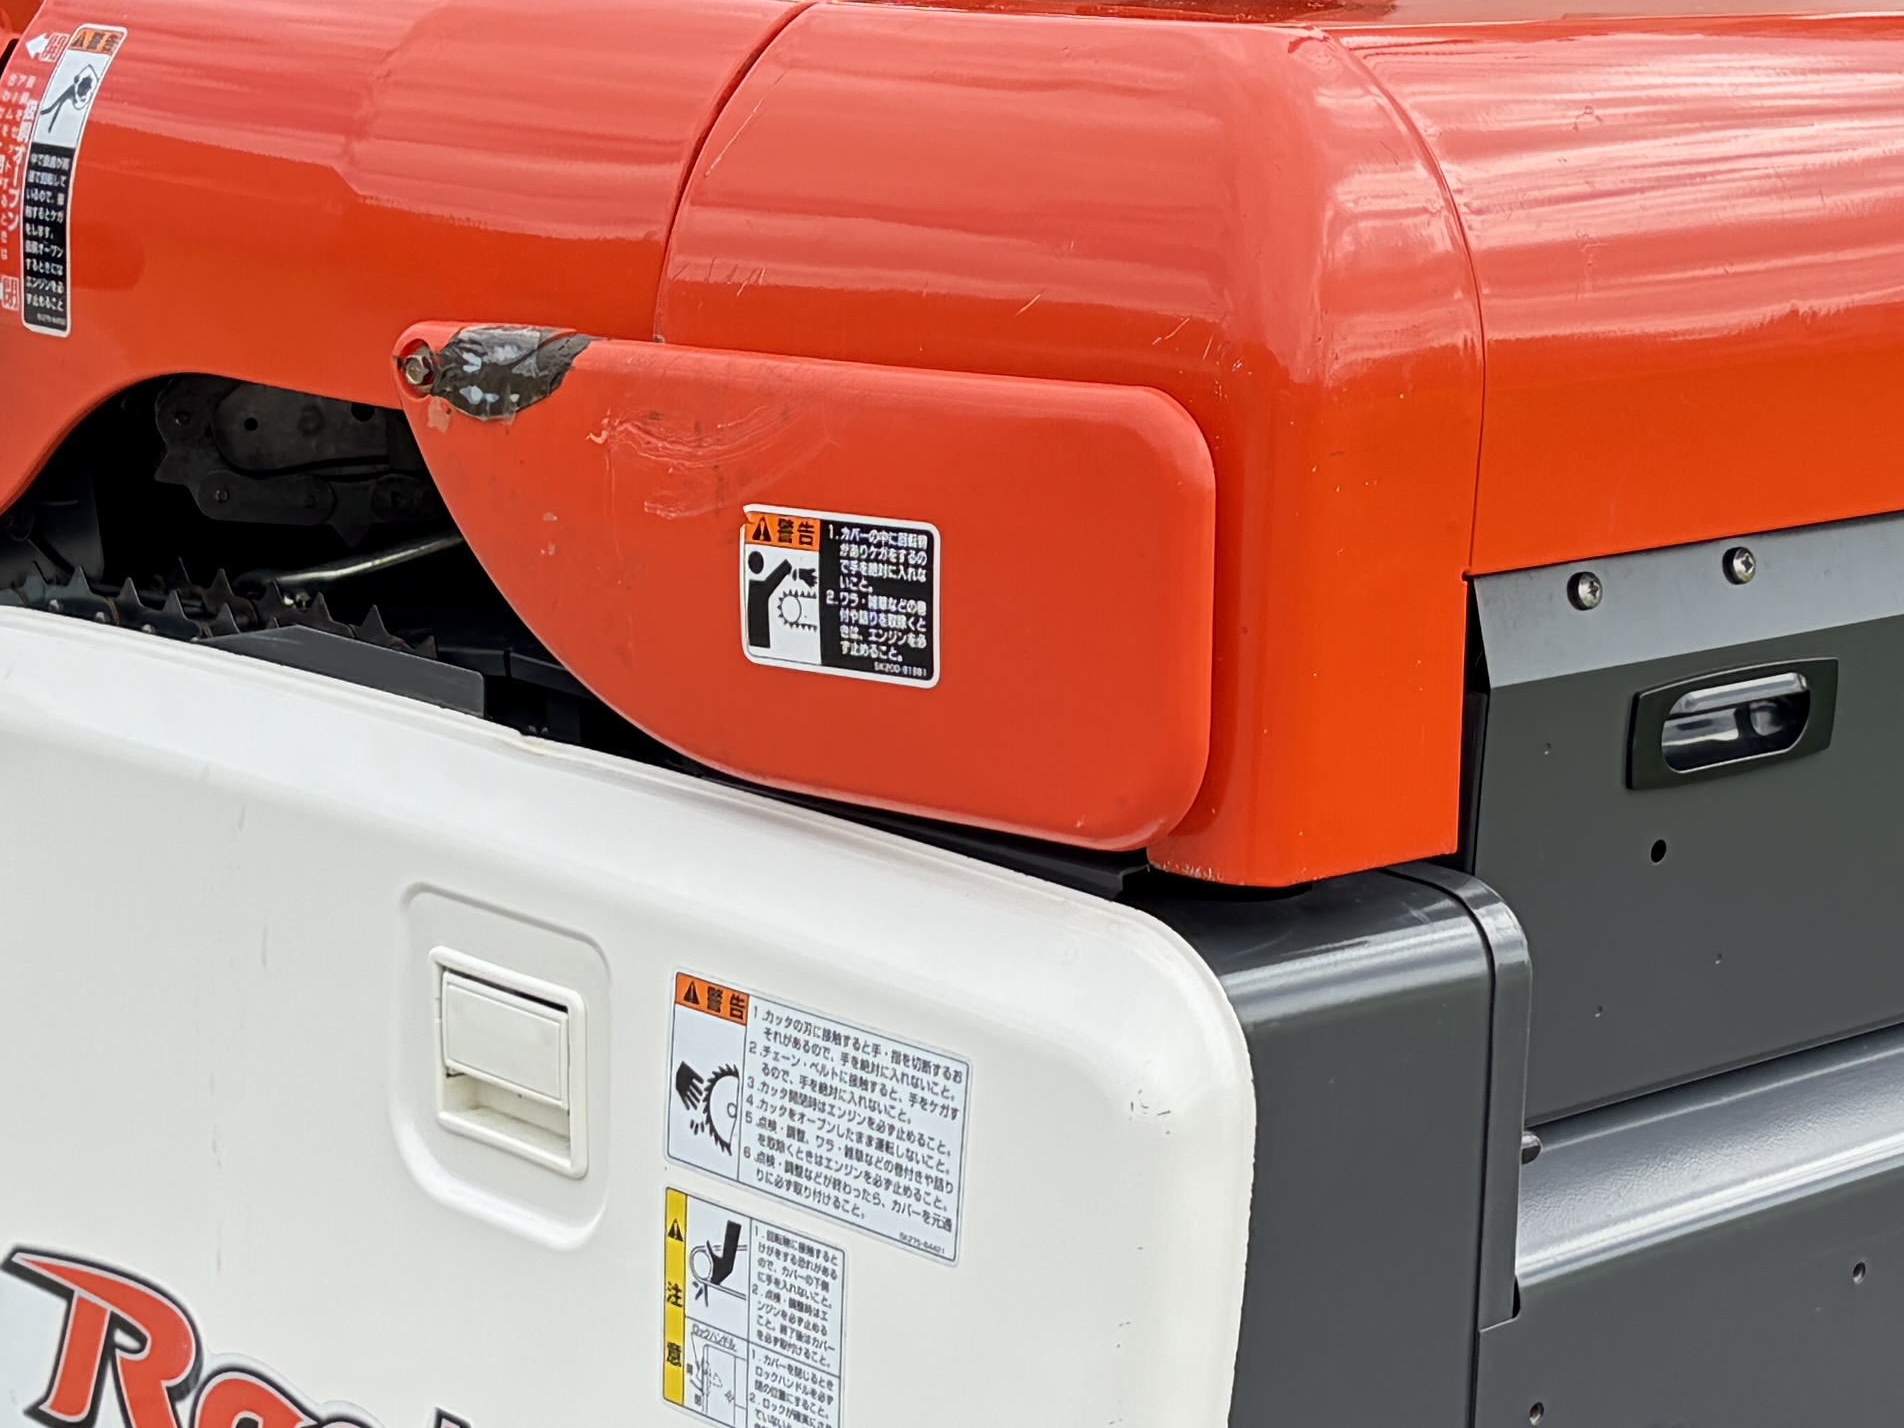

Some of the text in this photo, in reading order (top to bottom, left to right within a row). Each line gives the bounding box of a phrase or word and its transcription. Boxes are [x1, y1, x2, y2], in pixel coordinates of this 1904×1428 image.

[777, 517, 814, 546] 警告
[839, 574, 872, 592] いこと。
[706, 986, 745, 1019] 警告
[666, 1279, 683, 1368] 注意
